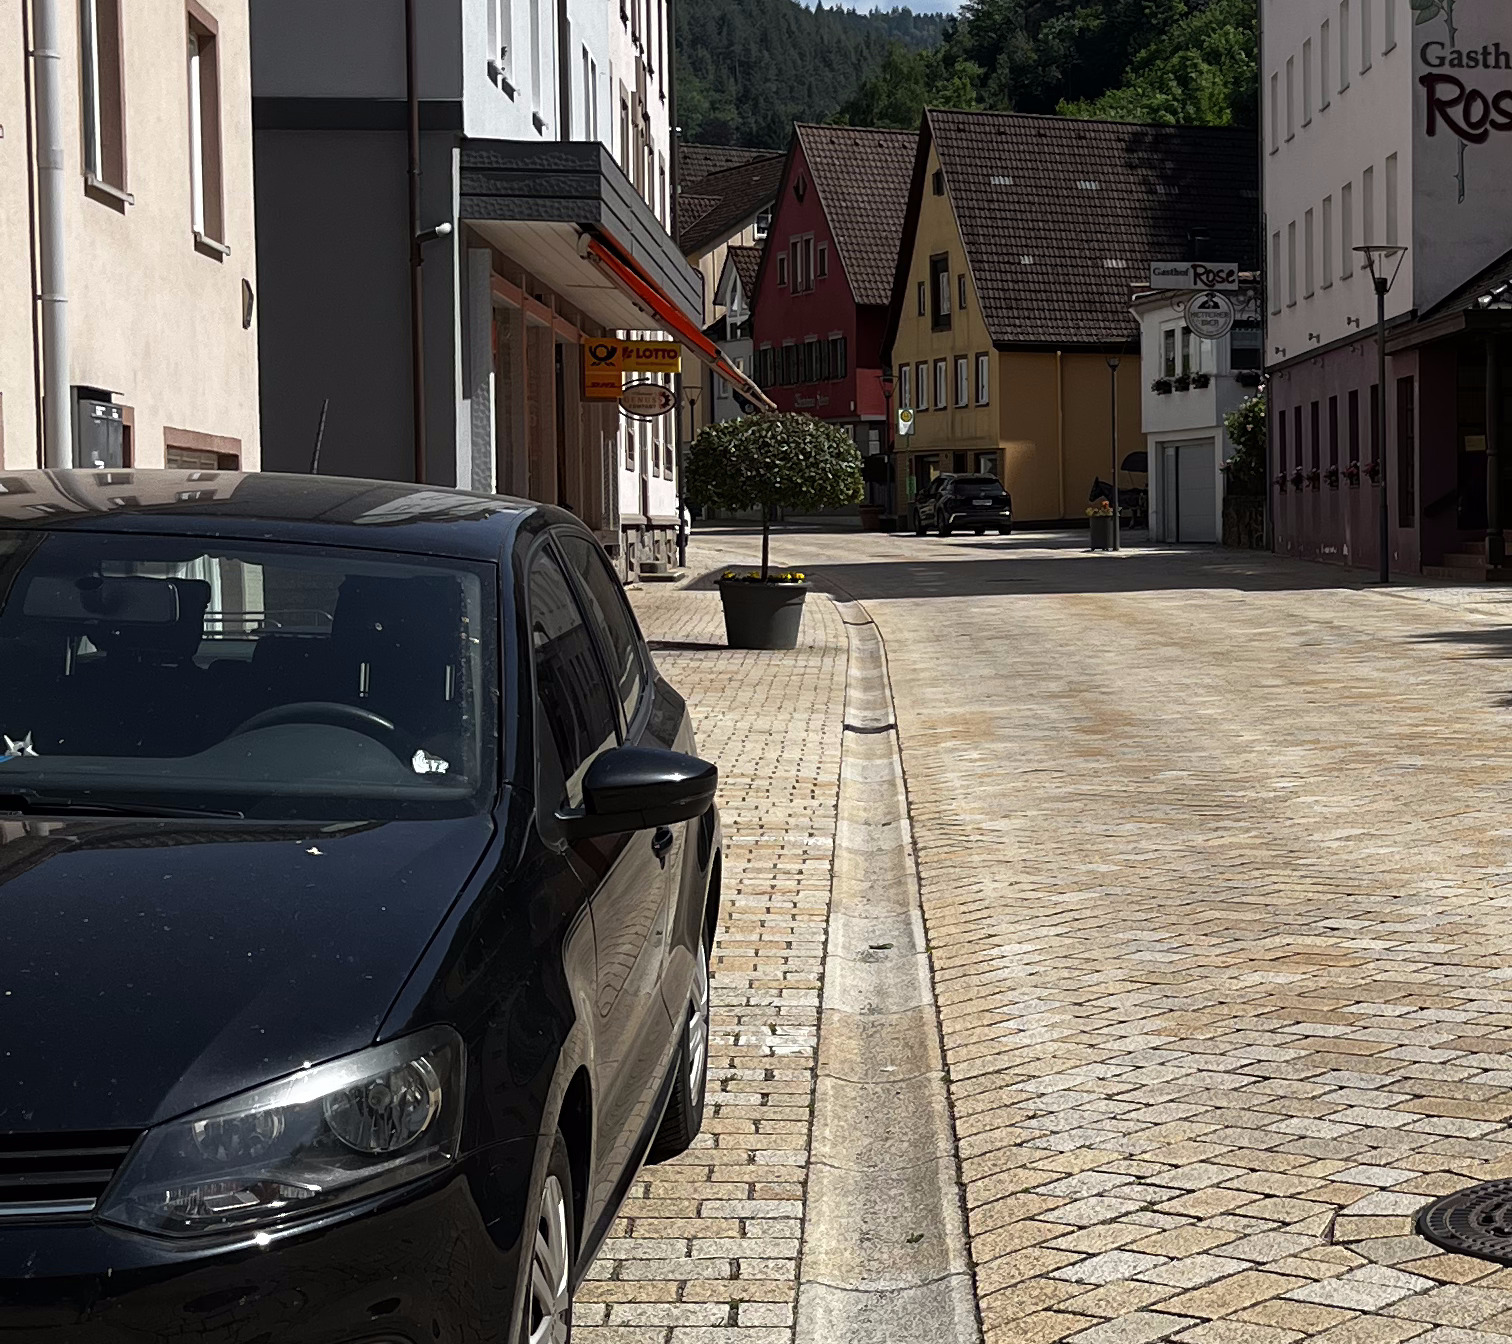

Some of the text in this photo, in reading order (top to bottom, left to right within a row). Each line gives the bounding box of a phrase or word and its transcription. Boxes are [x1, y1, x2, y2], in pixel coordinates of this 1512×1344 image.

[1153, 263, 1236, 288] Gasthof Rose
[636, 348, 678, 360] LOTTO
